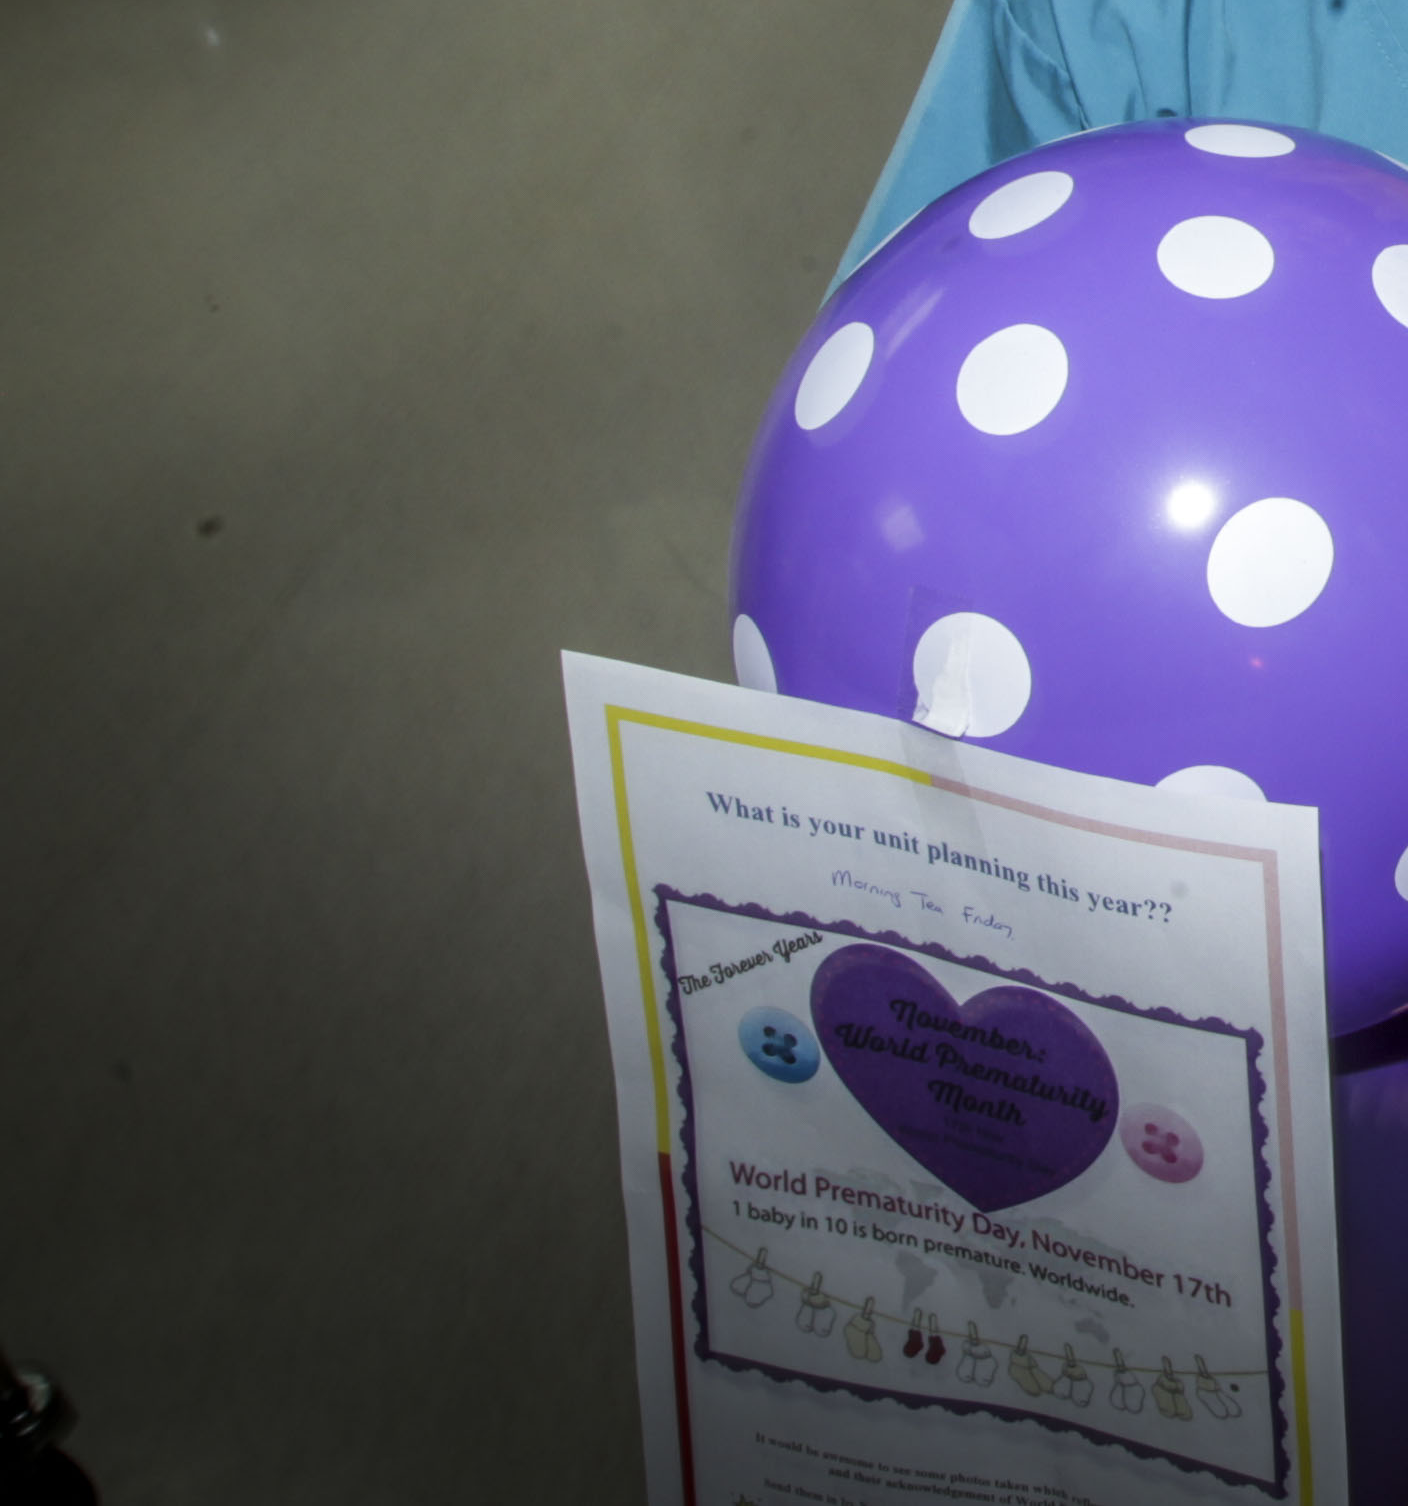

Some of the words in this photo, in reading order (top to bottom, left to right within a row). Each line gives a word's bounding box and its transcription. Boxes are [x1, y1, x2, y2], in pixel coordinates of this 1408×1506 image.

[706, 791, 774, 824] What
[782, 807, 800, 829] is
[809, 816, 865, 840] your
[873, 829, 920, 855] unit
[927, 841, 1031, 893] planning
[1036, 873, 1081, 903] this
[1087, 891, 1173, 924] year??
[832, 870, 902, 908] Morning
[909, 890, 945, 914] Tea
[678, 974, 712, 995] The
[709, 951, 774, 984] Forever
[772, 931, 823, 963] Years
[889, 998, 1047, 1063] November:
[834, 1022, 930, 1063] World
[934, 1041, 1109, 1123] Prematurity
[927, 1079, 1026, 1127] Month
[729, 1160, 807, 1196] World
[814, 1176, 965, 1234] Prematurity
[972, 1212, 1027, 1250] Day,
[1031, 1229, 1165, 1288] November
[1172, 1273, 1232, 1308] 17th
[732, 1200, 741, 1216] 1
[748, 1202, 796, 1230] baby
[800, 1211, 819, 1231] in
[825, 1216, 849, 1236] 10
[853, 1221, 867, 1239] is
[872, 1223, 919, 1248] born
[923, 1238, 1026, 1276] premature.
[1028, 1262, 1136, 1309] Worldwide.
[994, 1478, 1030, 1493] taken
